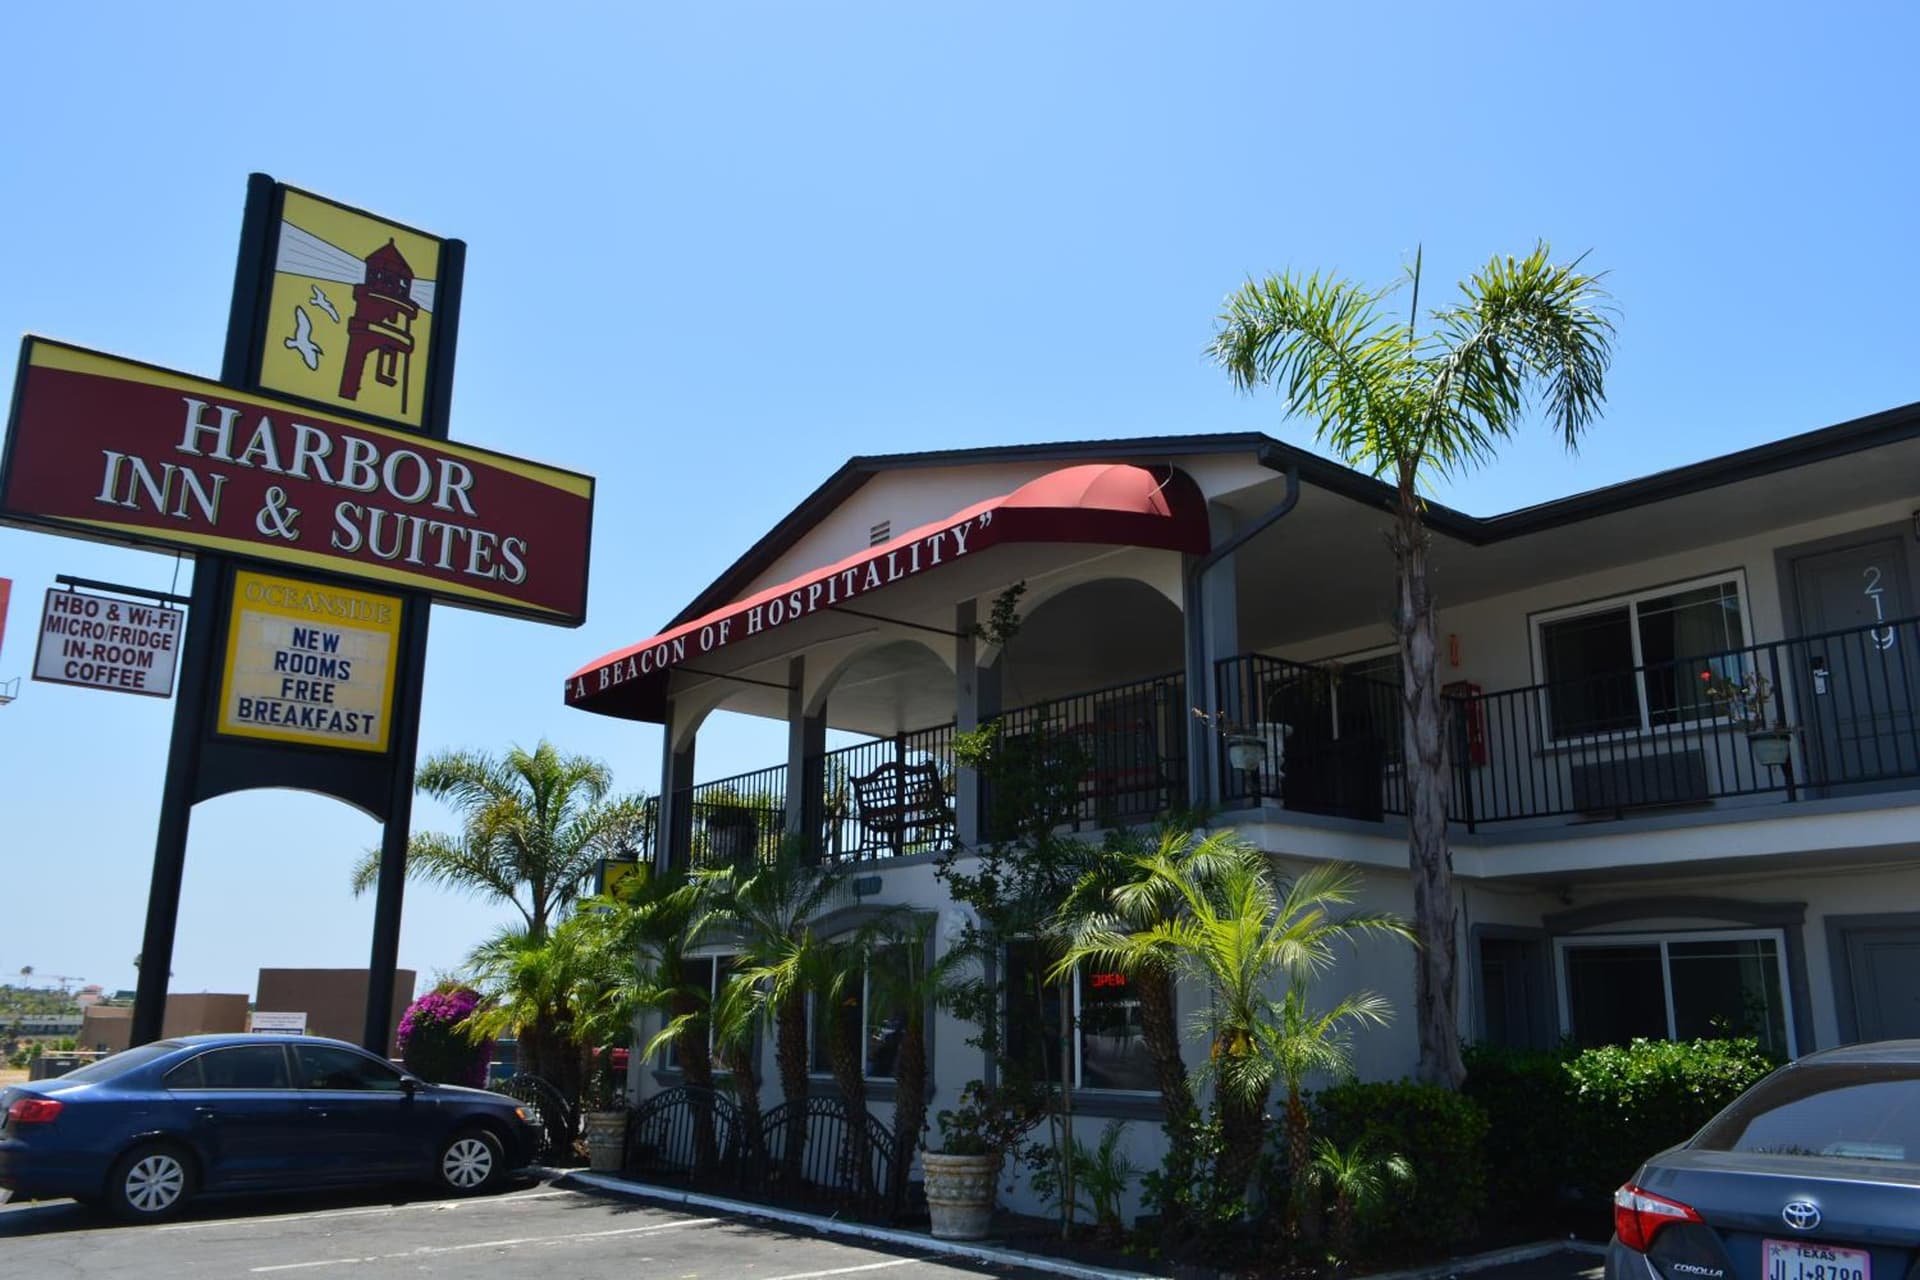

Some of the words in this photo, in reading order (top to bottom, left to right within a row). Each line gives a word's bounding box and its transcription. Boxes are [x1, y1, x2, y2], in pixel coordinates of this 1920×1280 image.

[175, 397, 479, 518] HARBOR
[94, 449, 229, 526] INN
[255, 485, 302, 542] &
[331, 500, 529, 585] SUITES
[53, 594, 100, 618] HBO
[106, 603, 120, 622] &
[128, 607, 176, 632] Wi-Fi
[245, 581, 393, 625] OCEANSIDE
[1863, 566, 1894, 650] 219
[46, 614, 173, 652] MICRO/FRIDGE
[292, 626, 341, 653] NEW
[62, 639, 154, 669] IN-ROOM
[274, 651, 352, 681] ROOMS
[599, 636, 687, 691] BEACON
[700, 618, 732, 652] OF
[64, 660, 147, 689] COFFEE
[281, 677, 336, 704] FREE
[237, 697, 375, 735] BREAKFAST
[1674, 1263, 1724, 1278] COROLLA
[1797, 1247, 1837, 1262] TEXAS
